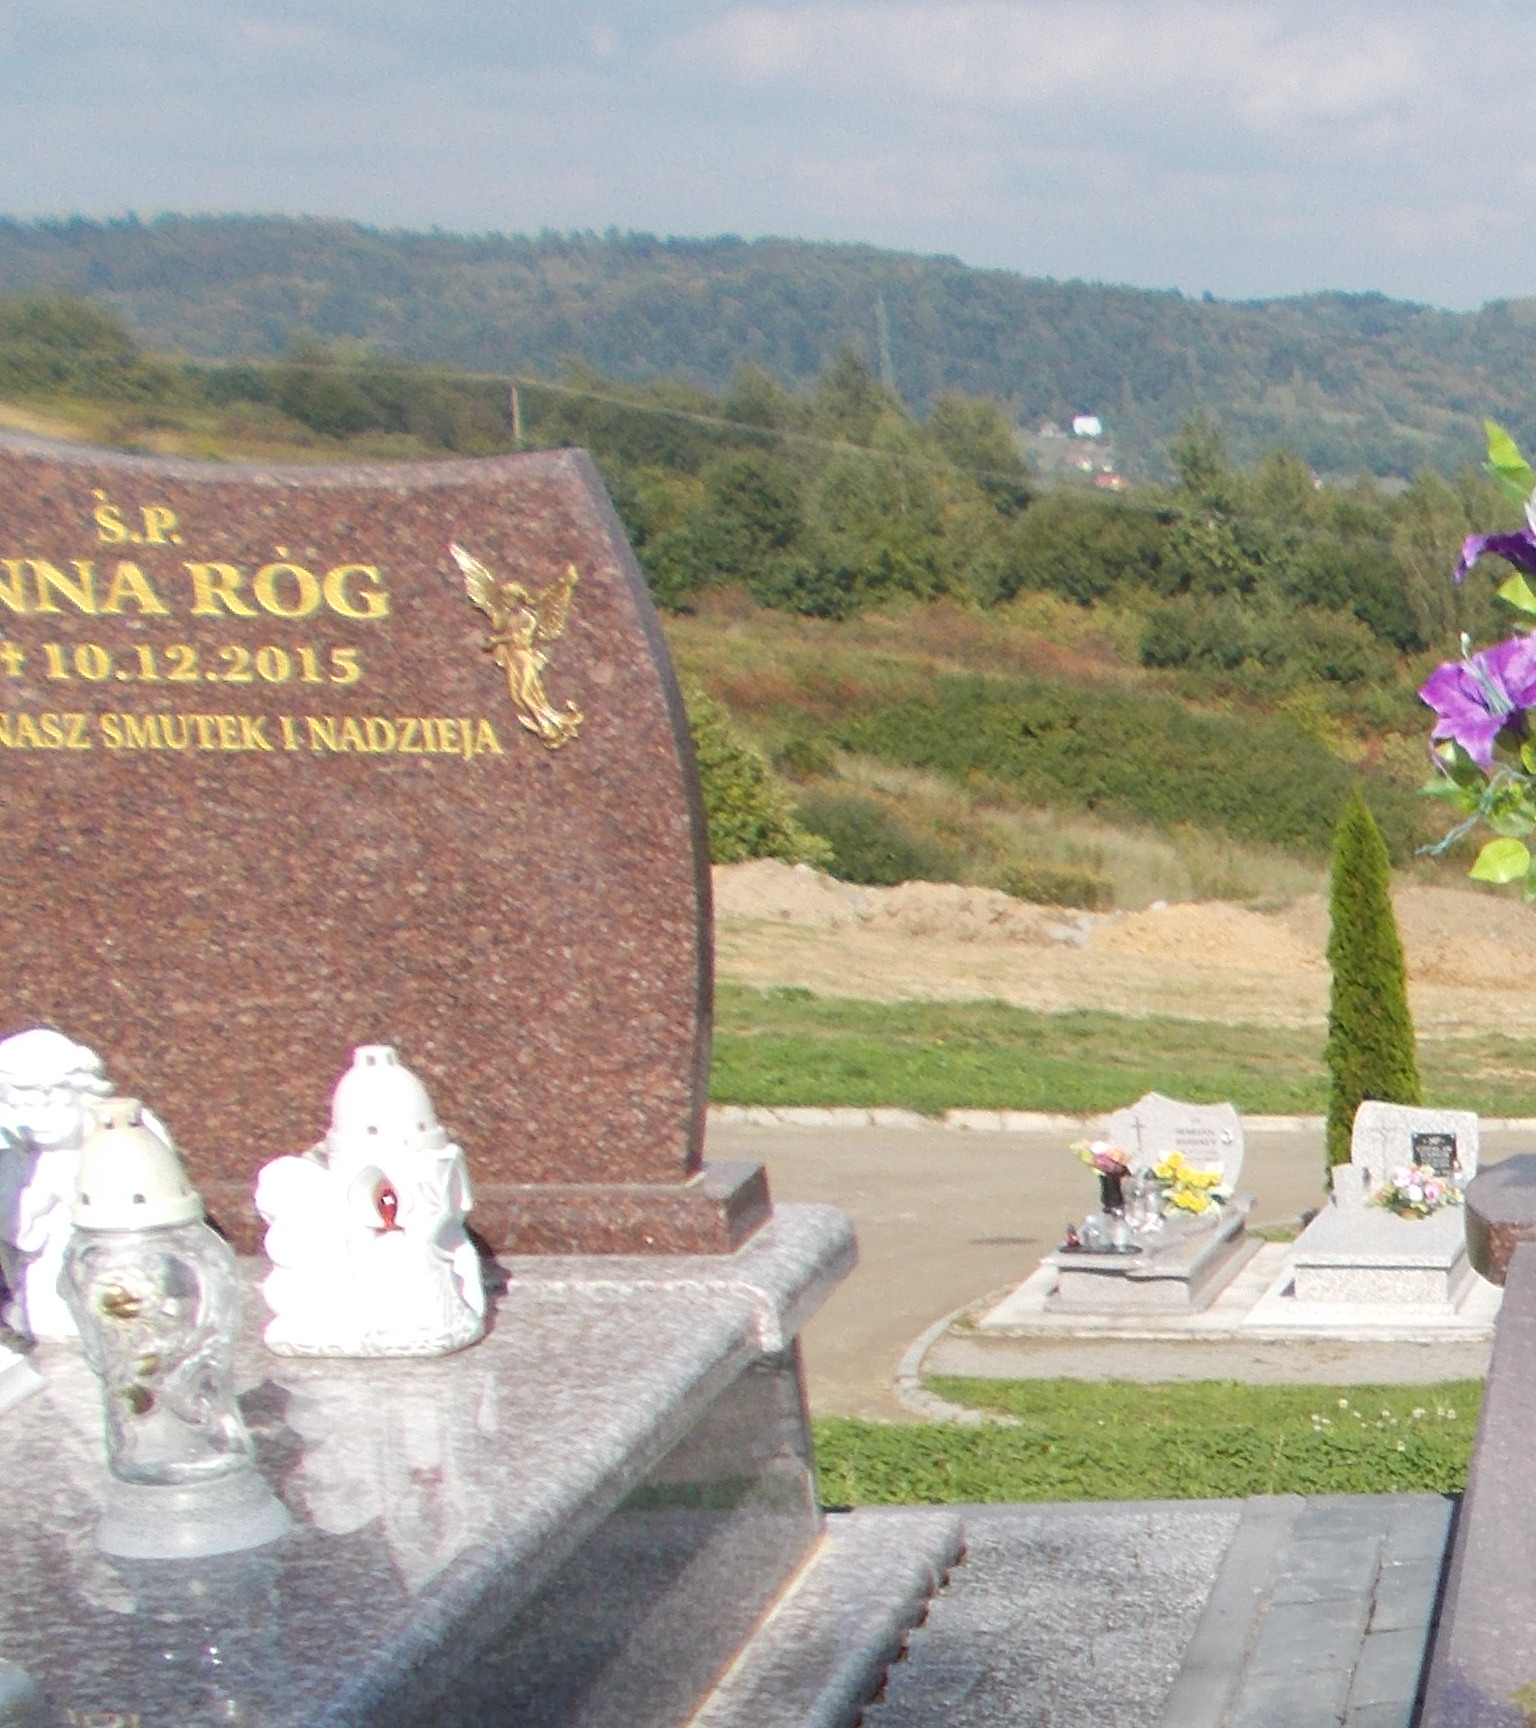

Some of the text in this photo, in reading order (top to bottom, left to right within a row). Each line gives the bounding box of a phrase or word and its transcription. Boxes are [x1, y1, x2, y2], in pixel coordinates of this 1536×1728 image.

[92, 489, 183, 545] Ś.P.
[183, 546, 390, 619] RÓG
[43, 640, 362, 684] 10.12.2015
[99, 713, 273, 754] SMUTEK
[281, 716, 302, 752] I
[306, 717, 504, 760] NADZIEJA
